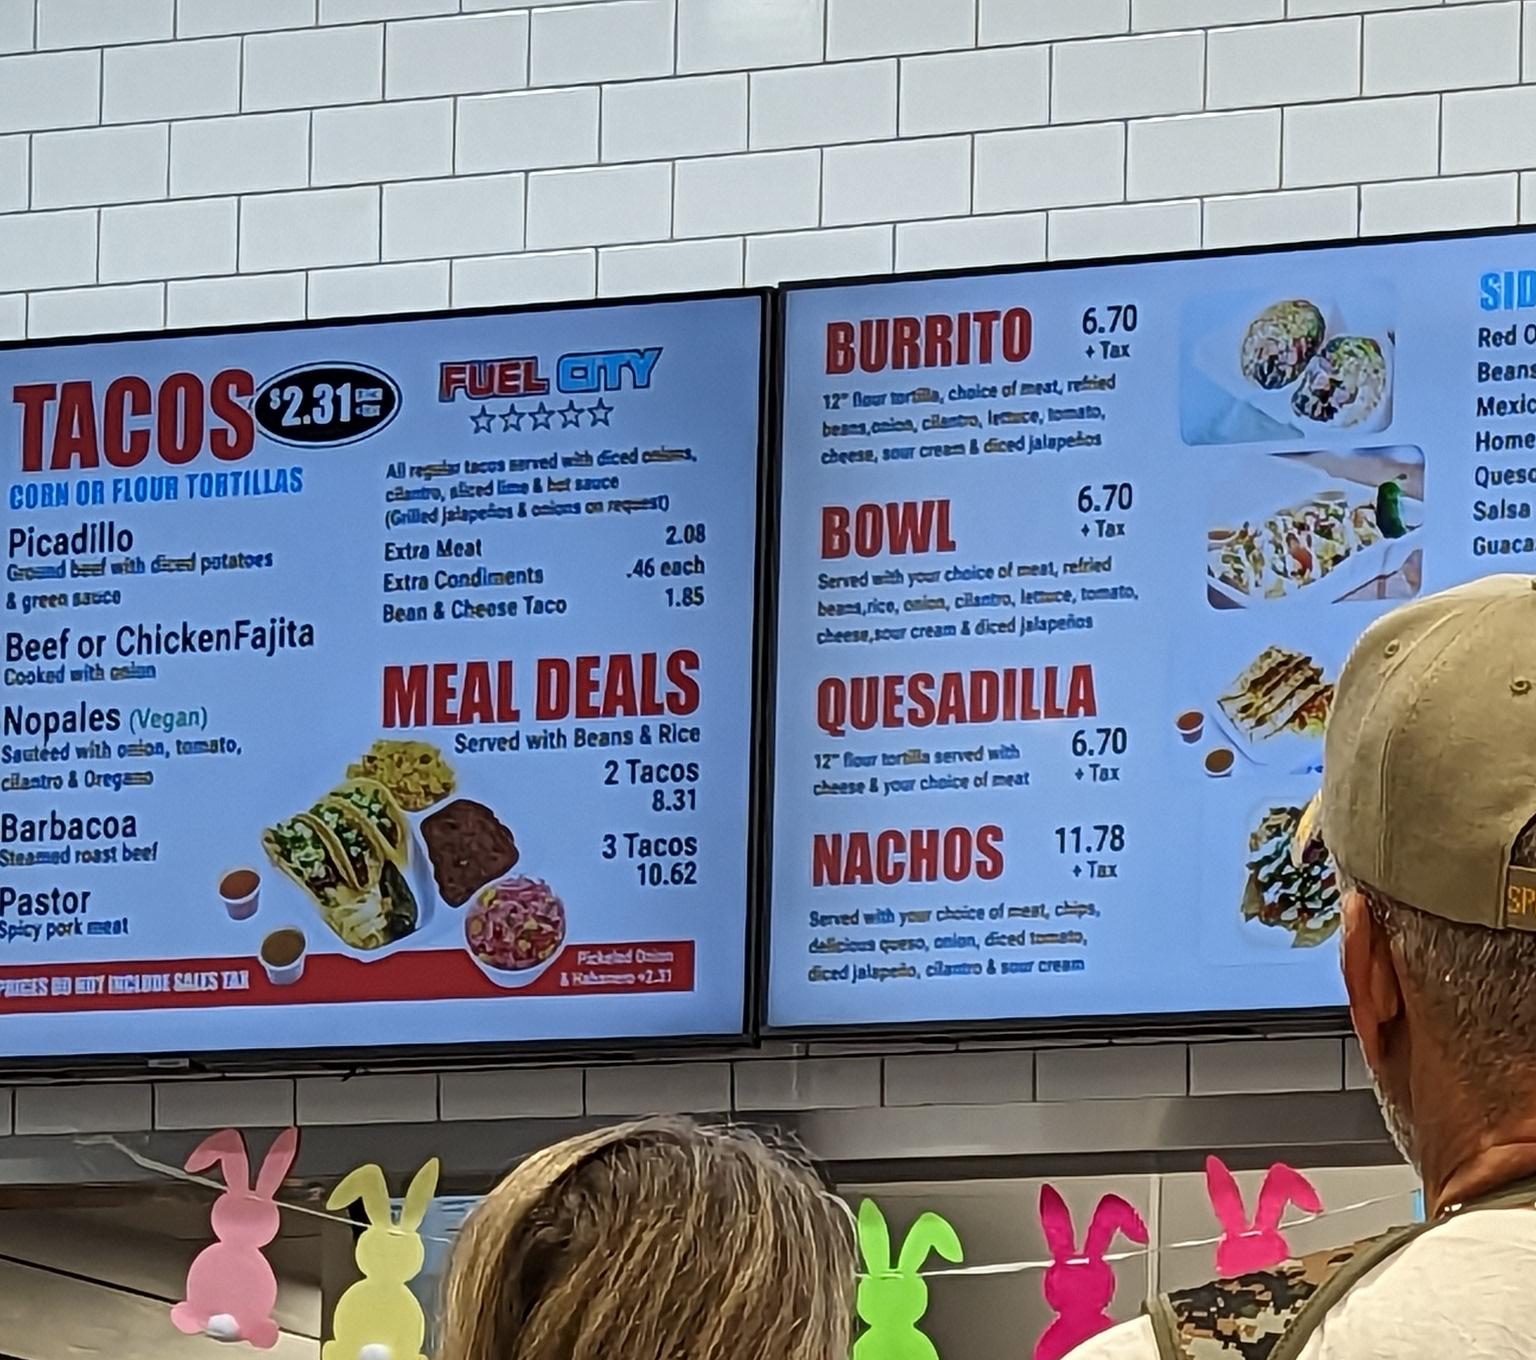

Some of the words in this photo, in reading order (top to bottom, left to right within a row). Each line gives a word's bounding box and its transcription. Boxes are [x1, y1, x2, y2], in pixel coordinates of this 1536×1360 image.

[1082, 304, 1137, 335] 6.70
[825, 307, 1032, 375] BURRITO
[1100, 340, 1130, 359] Tax
[1478, 324, 1517, 348] Red
[438, 356, 550, 402] FUEL
[556, 347, 664, 394] CITY
[269, 382, 352, 427] $2.31
[13, 368, 256, 472] TACOS
[10, 481, 69, 510] CORN
[75, 479, 104, 506] OR
[113, 475, 179, 504] FLOUR
[186, 466, 304, 499] TORTILLAS
[1077, 482, 1133, 513] 6.70
[1473, 498, 1531, 521] Salsa
[9, 520, 134, 558] Picadillo
[384, 542, 430, 562] Extra
[437, 539, 482, 558] Meat
[666, 523, 706, 545] 2.08
[821, 499, 956, 560] BOWL
[1095, 518, 1126, 538] Tax
[111, 557, 145, 575] with
[201, 552, 273, 576] potatoes
[383, 573, 429, 592] Extra
[434, 567, 544, 591] Condiments
[626, 557, 655, 579] .46
[660, 554, 705, 577] each
[817, 569, 869, 590] Served
[944, 564, 995, 582] choice
[998, 561, 1013, 579] of
[1062, 555, 1112, 576] refried
[22, 593, 68, 614] green
[383, 603, 427, 623] Bean
[433, 601, 445, 620] &
[452, 599, 517, 620] Cheese
[523, 595, 567, 616] Taco
[665, 586, 704, 608] 1.85
[910, 623, 957, 639] cream
[974, 616, 1016, 636] diced
[6, 628, 70, 662] Beef
[77, 636, 107, 659] or
[4, 664, 65, 686] Cooked
[70, 662, 104, 682] with
[382, 661, 520, 728] MEAL
[536, 649, 700, 721] DEALS
[817, 664, 1098, 737] QUESADILLA
[3, 701, 121, 744] Nopales
[129, 706, 208, 734] (Vegan)
[455, 729, 519, 753] Served
[526, 727, 567, 749] with
[574, 726, 633, 747] Beans
[640, 724, 651, 744] &
[659, 722, 700, 743] Rice
[75, 740, 112, 759] with
[176, 737, 242, 756] tomato,
[843, 750, 878, 768] flour
[881, 747, 930, 766] tortilla
[934, 745, 984, 764] served
[988, 744, 1020, 762] with
[1071, 727, 1128, 757] 6.70
[604, 760, 618, 785] 2
[626, 759, 699, 784] Tacos
[813, 777, 866, 796] cheese
[883, 780, 916, 797] your
[920, 772, 969, 790] choice
[973, 770, 988, 788] of
[992, 771, 1030, 788] meat
[1089, 763, 1120, 783] Tax
[652, 789, 696, 811] 8.31
[1, 810, 137, 843] Barbacoa
[1054, 824, 1126, 854] 11.78
[0, 845, 70, 868] Steamed
[75, 844, 118, 864] roast
[122, 841, 158, 862] beef
[602, 834, 616, 859] 3
[624, 833, 698, 858] Tacos
[812, 824, 1005, 887] NACHOS
[637, 862, 697, 887] 10.62
[1086, 860, 1118, 879] Tax
[0, 886, 91, 917] Pastor
[0, 920, 42, 944] Spicy
[46, 916, 83, 938] pork
[87, 917, 128, 936] meat
